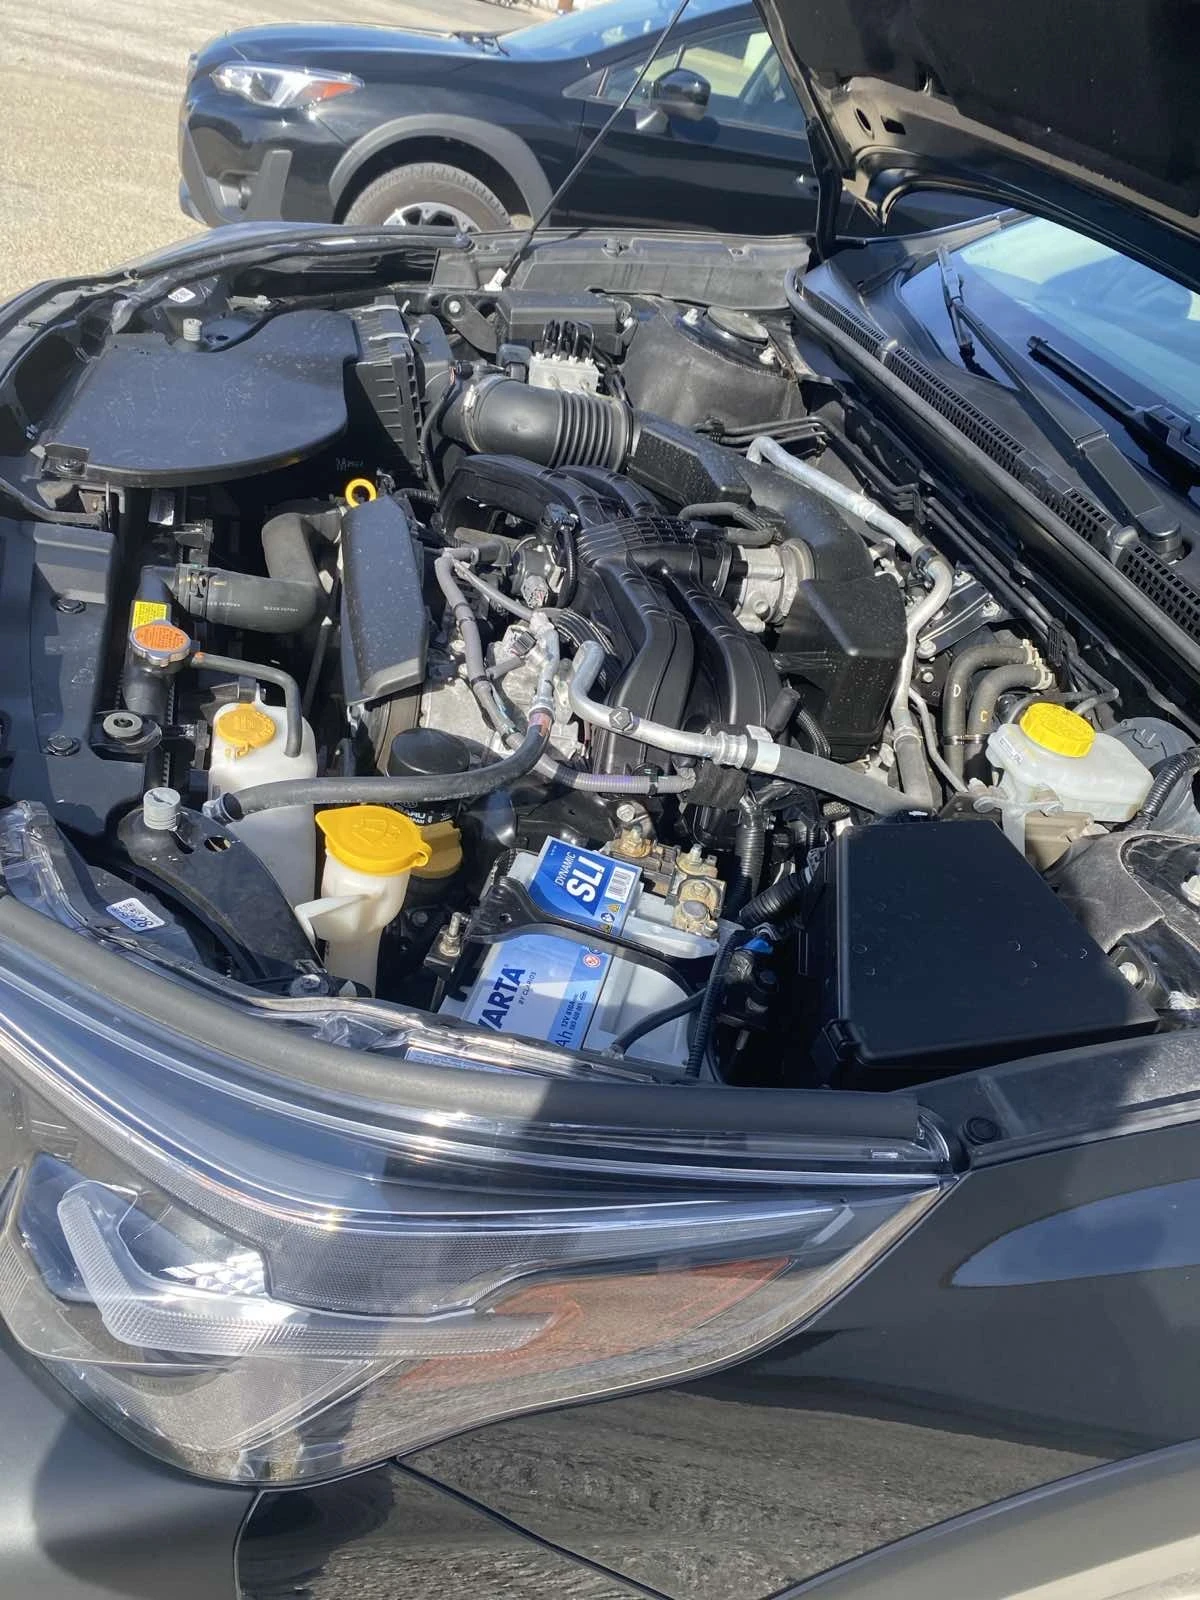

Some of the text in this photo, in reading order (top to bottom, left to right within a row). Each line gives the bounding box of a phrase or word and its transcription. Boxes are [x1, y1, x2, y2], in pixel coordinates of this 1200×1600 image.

[953, 684, 961, 697] D
[981, 710, 988, 722] C
[554, 851, 576, 886] DYNAMIC
[566, 855, 605, 903] SLI
